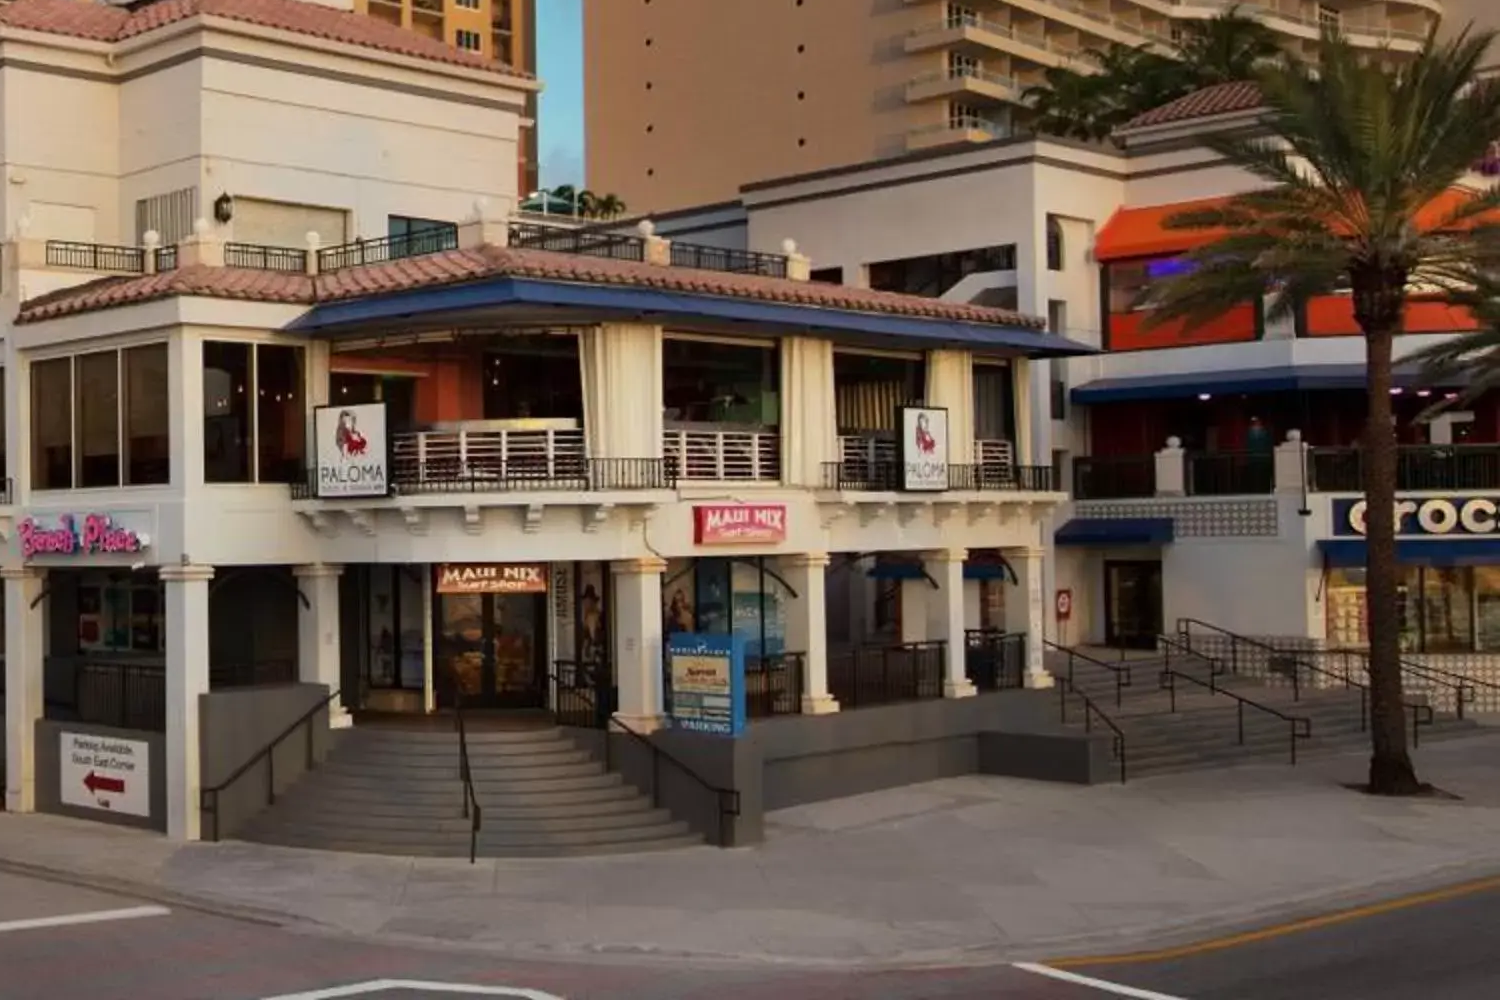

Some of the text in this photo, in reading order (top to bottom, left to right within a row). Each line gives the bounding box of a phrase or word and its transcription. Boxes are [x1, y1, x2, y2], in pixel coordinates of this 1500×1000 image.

[320, 465, 385, 483] PALOMA
[906, 461, 946, 479] PALOMA
[706, 507, 784, 532] MAUI NIX
[442, 566, 541, 585] MAUI NIX
